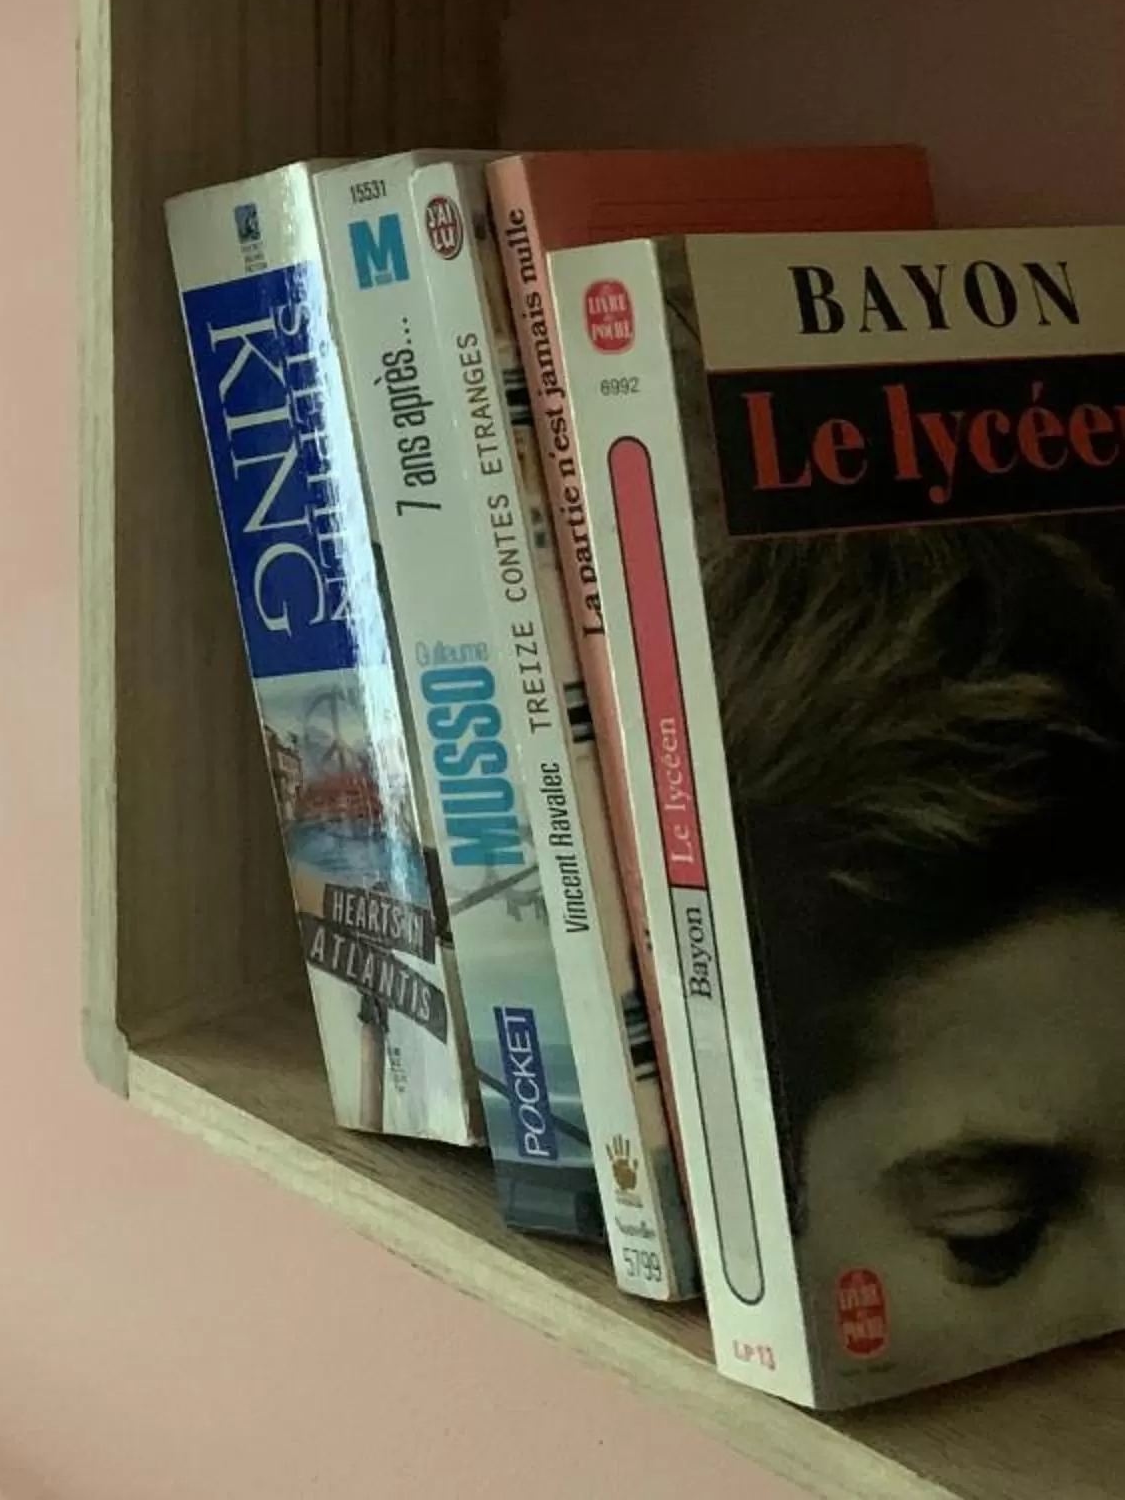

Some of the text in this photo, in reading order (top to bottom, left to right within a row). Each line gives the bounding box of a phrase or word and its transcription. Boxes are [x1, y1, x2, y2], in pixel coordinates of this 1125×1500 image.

[350, 179, 388, 204] 15531
[433, 227, 456, 250] LU
[787, 259, 1080, 334] BAYON
[505, 206, 607, 640] La partie n'est jamais nulle
[599, 375, 641, 397] 6992
[206, 307, 325, 638] KING
[397, 437, 438, 488] ans
[742, 391, 869, 491] Le
[396, 500, 442, 517] 7
[457, 332, 553, 735] TREIZE CONTES ETRANGES
[420, 664, 526, 866] MUSSO
[654, 713, 694, 865] Le lycéen
[540, 761, 590, 935] Vincent Ravalec
[332, 890, 425, 954] HEARTS IN
[686, 906, 713, 1000] Bayon
[310, 926, 431, 1022] ATLANTIS
[501, 1005, 551, 1157] POCKET
[622, 1247, 663, 1283] 5799
